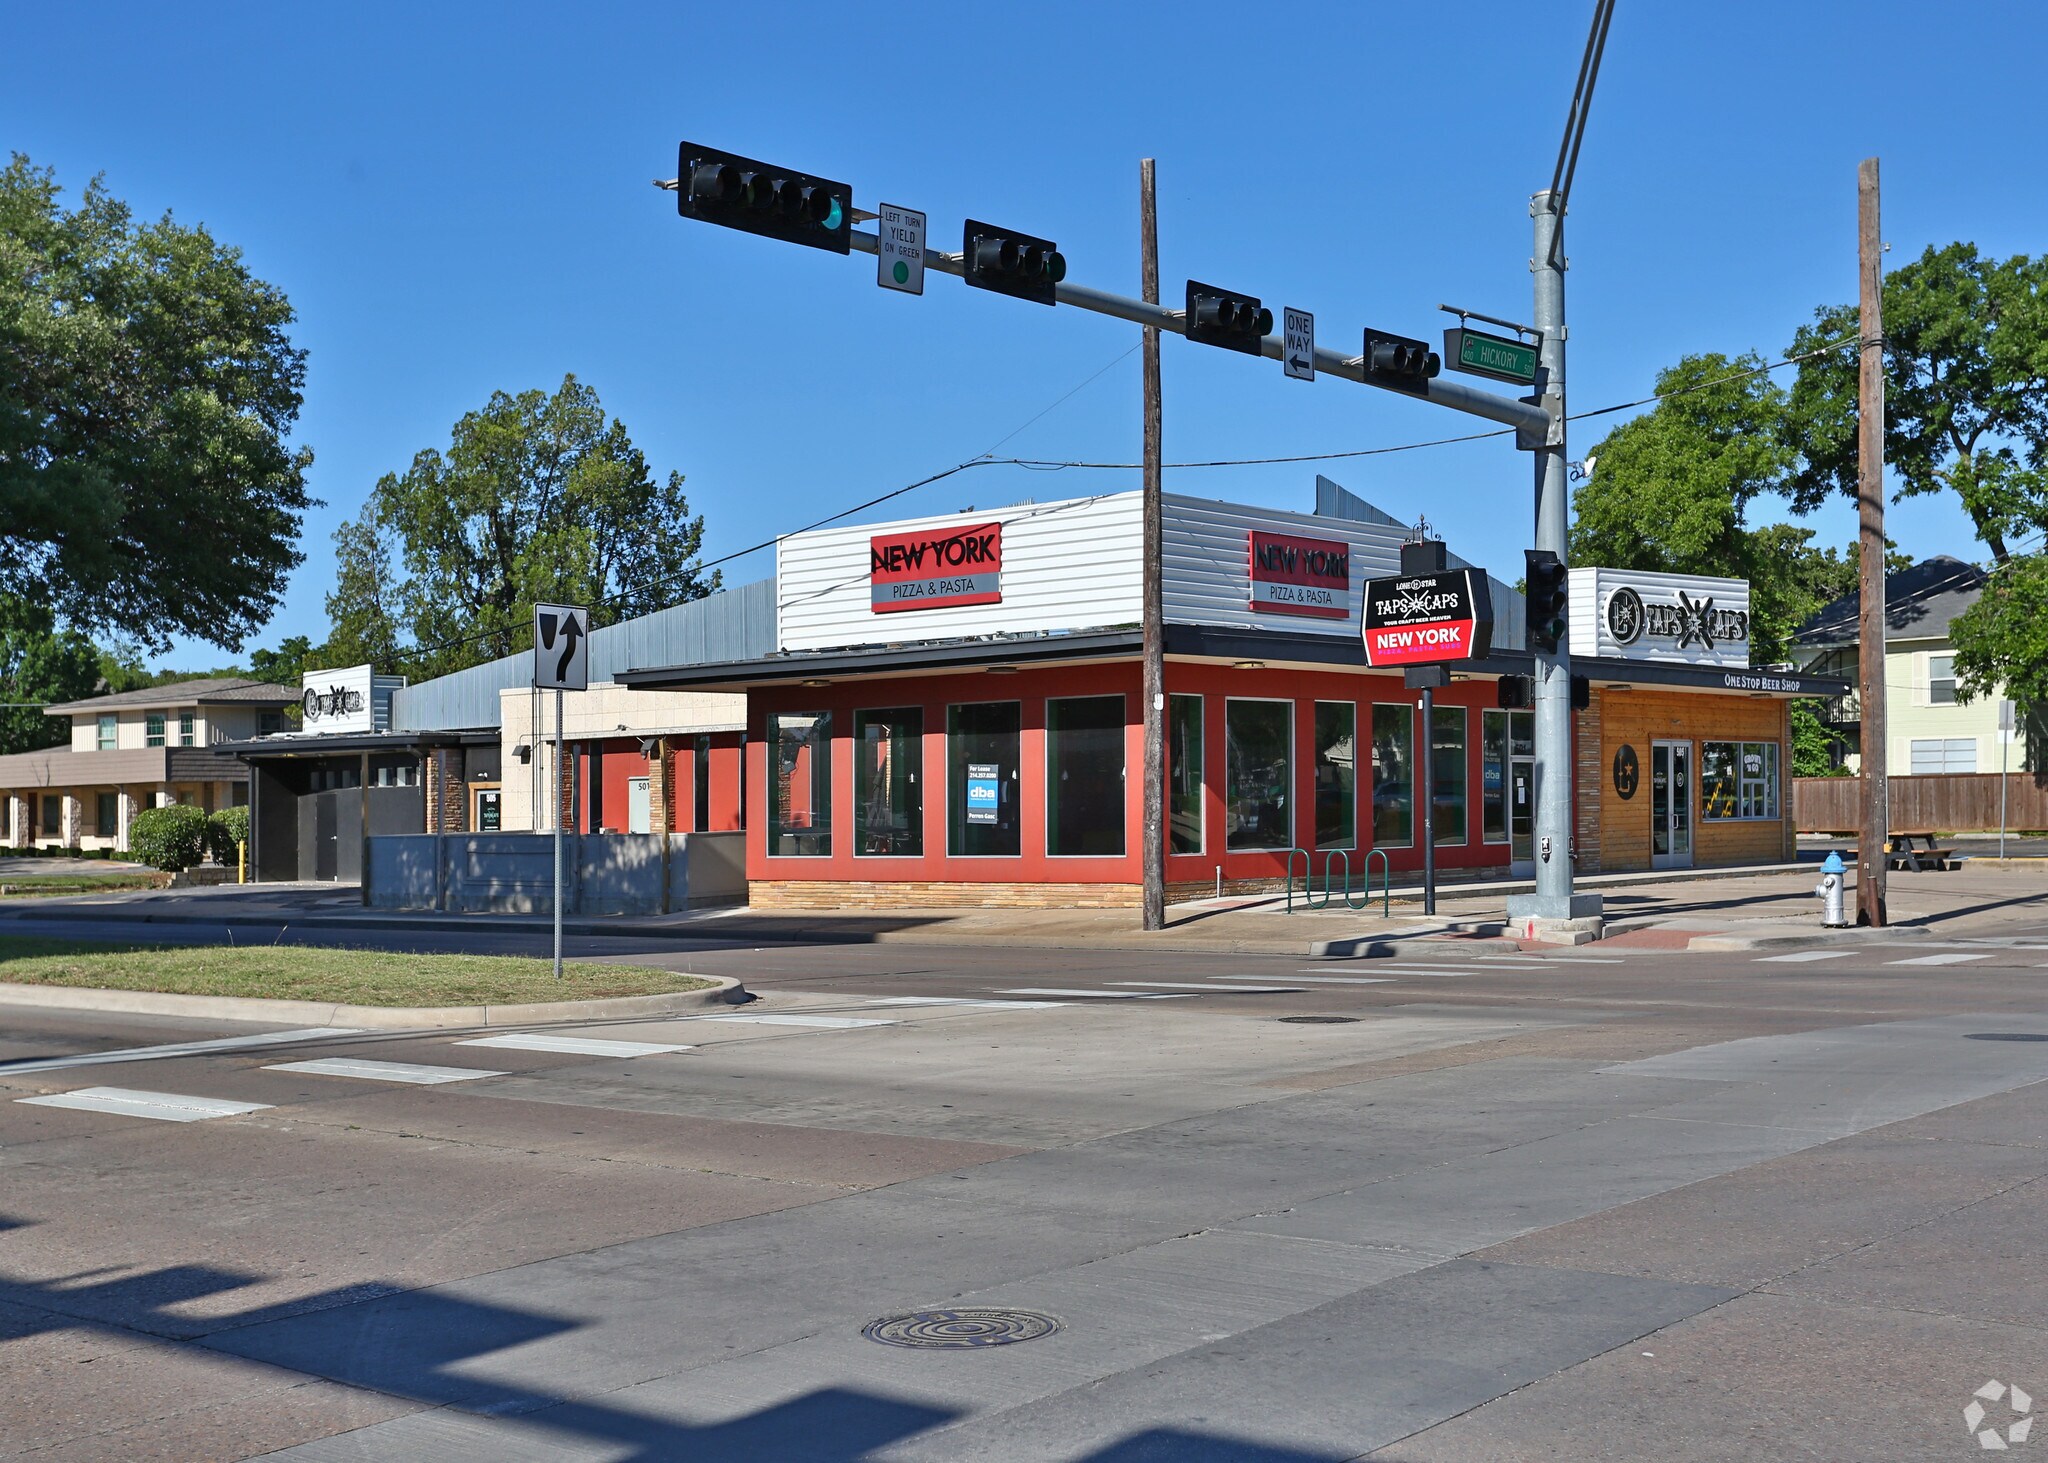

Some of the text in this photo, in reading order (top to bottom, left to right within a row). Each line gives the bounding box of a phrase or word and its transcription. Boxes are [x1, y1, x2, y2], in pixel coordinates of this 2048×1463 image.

[885, 211, 920, 229] LEFT TURN
[891, 226, 915, 244] YIELD
[884, 242, 920, 259] ON GREEN
[1288, 314, 1310, 334] ONE
[1287, 333, 1310, 353] WAY
[1480, 346, 1519, 369] HICKORY
[871, 534, 996, 575] NEW YORK
[1254, 540, 1349, 579] NEW YORK
[893, 578, 975, 599] PIZZA & PASTA
[1270, 585, 1333, 605] PIZZA & PASTA
[1395, 579, 1437, 591] LONE STAR
[1375, 592, 1459, 616] TAPS CAPS
[1429, 614, 1452, 622] HEAVEN
[1647, 604, 1686, 636] TAPS
[1377, 626, 1461, 650] NEW YORK
[1724, 673, 1801, 692] ONE STOP BEER SHOP
[1485, 769, 1500, 780] dba
[638, 782, 650, 791] 501
[970, 786, 995, 798] dba
